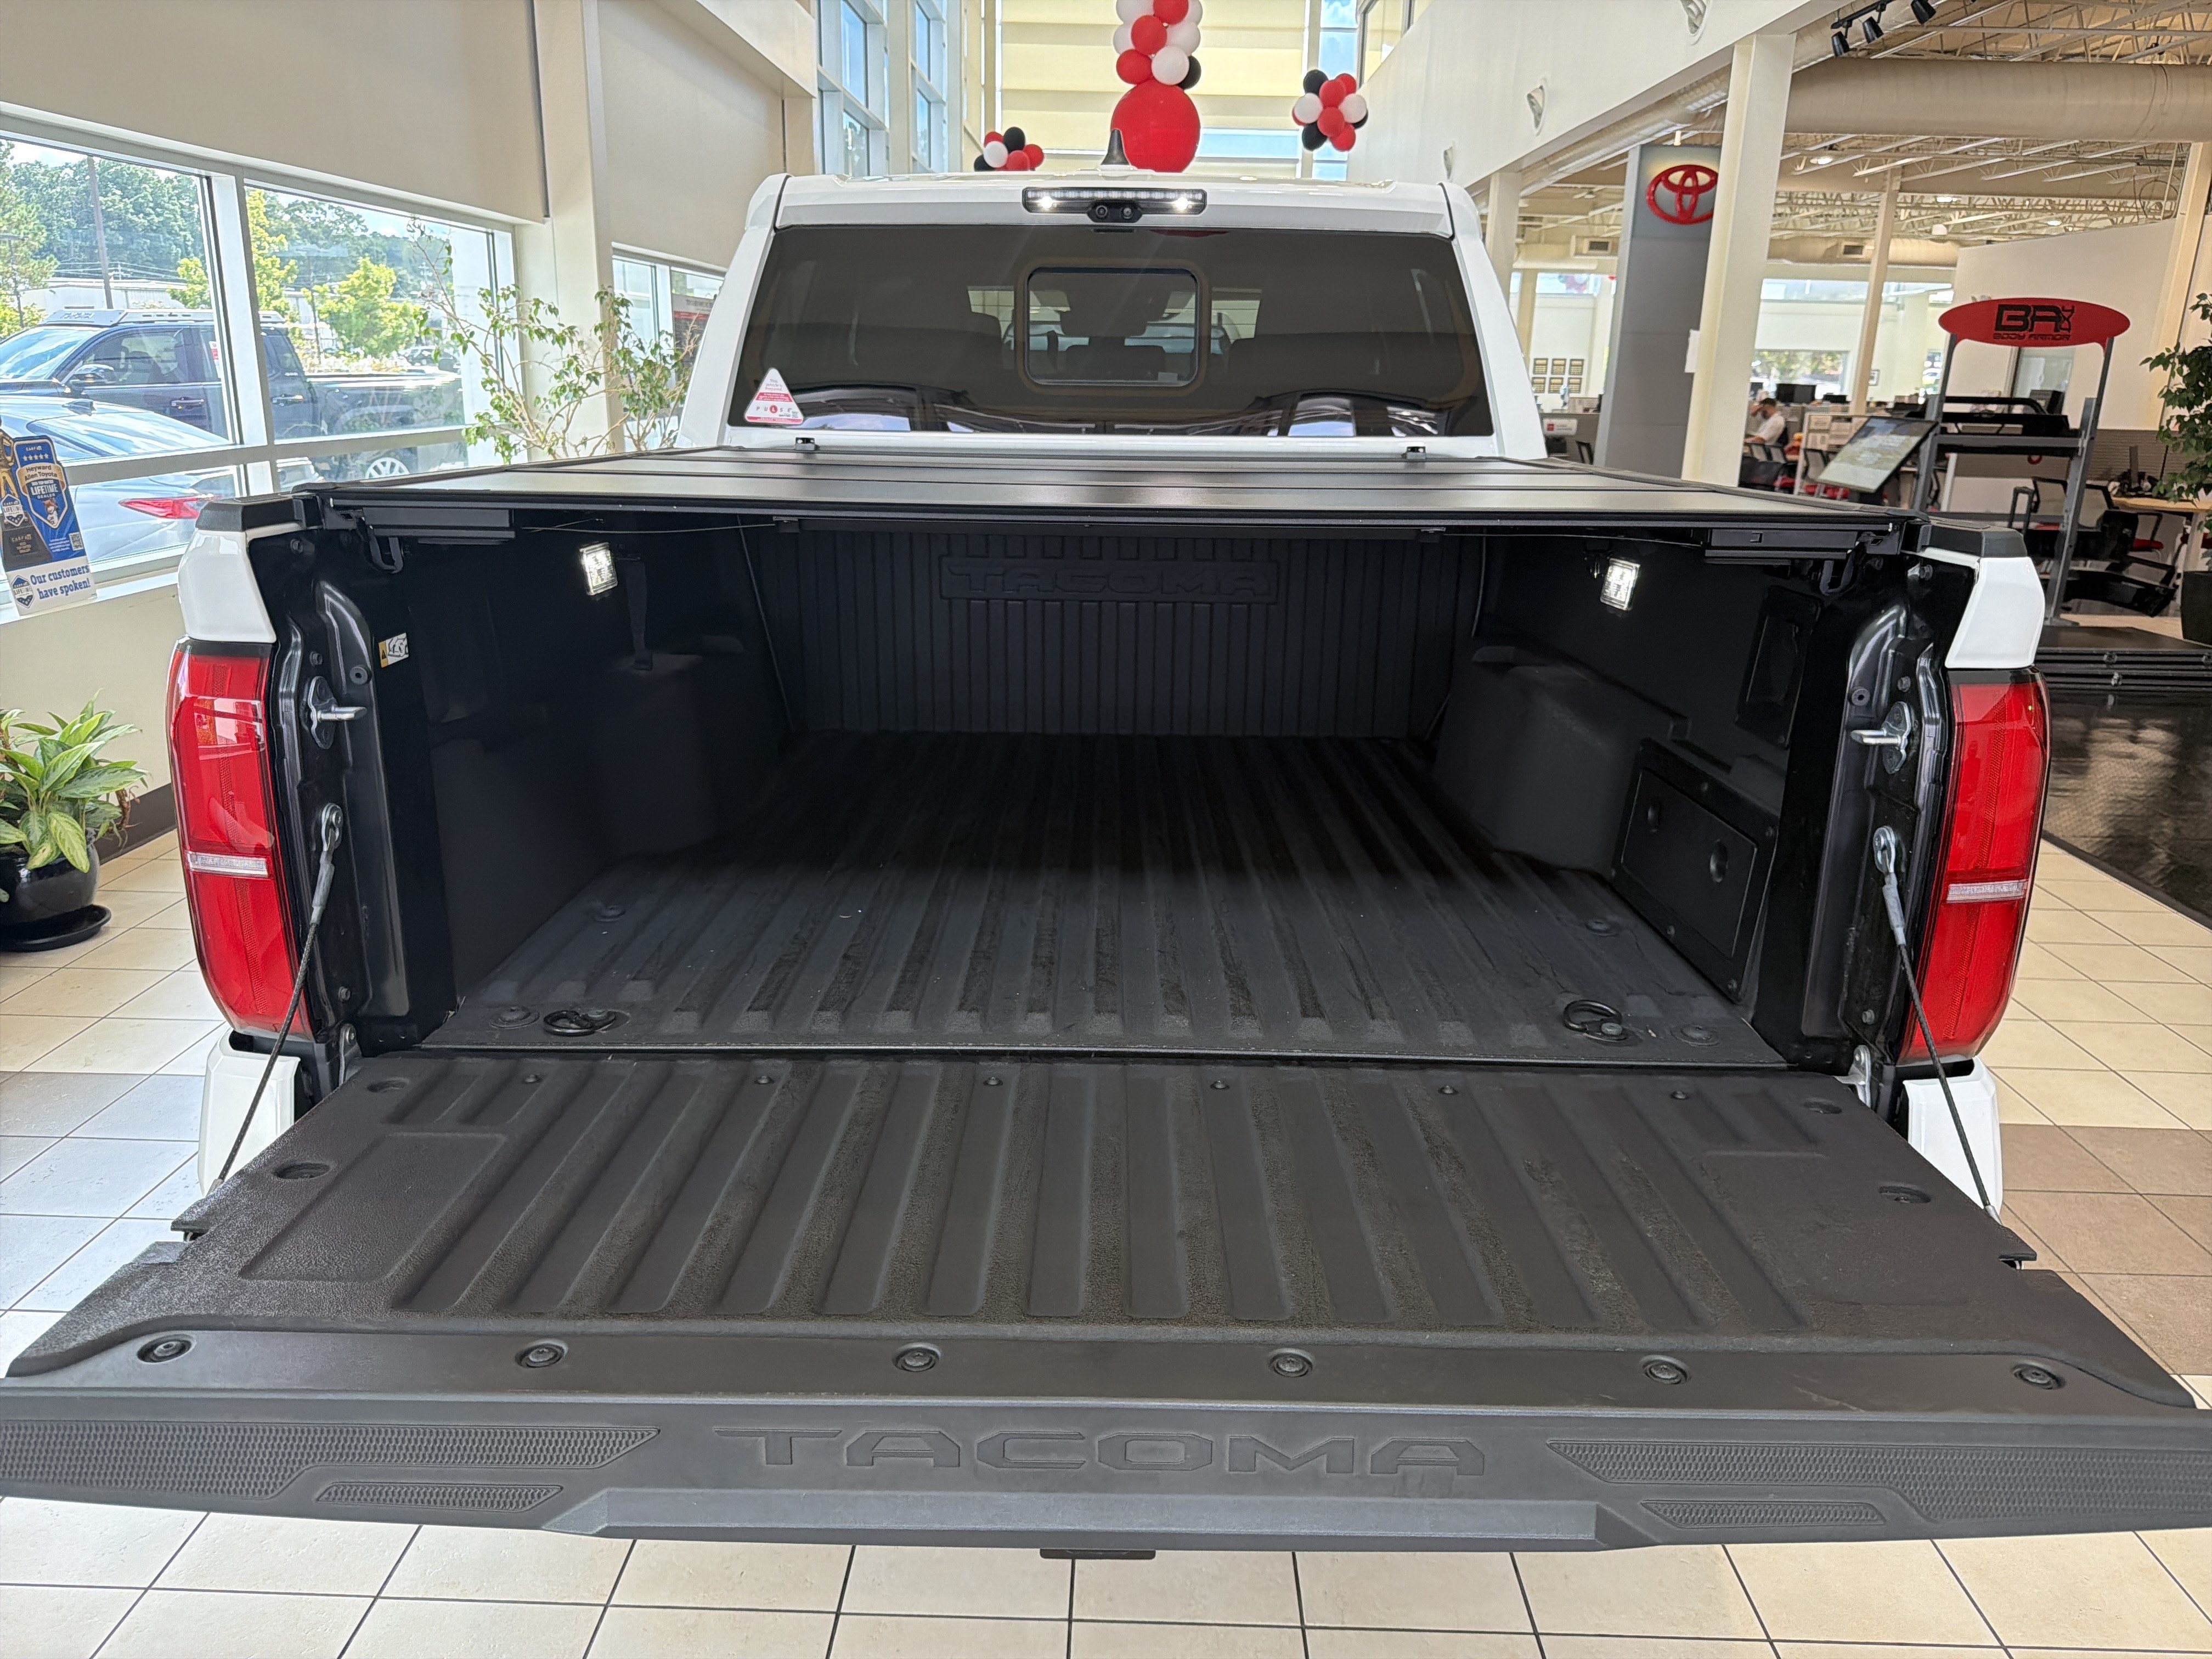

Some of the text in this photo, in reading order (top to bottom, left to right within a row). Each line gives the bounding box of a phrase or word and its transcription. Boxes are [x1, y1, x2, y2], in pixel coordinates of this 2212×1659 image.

[25, 472, 38, 481] Allen
[30, 484, 58, 495] LIFETIME
[30, 565, 90, 585] Our customers
[948, 566, 1269, 596] TACOMA
[37, 577, 91, 600] have spoken!
[713, 1427, 1486, 1476] TACOMA
